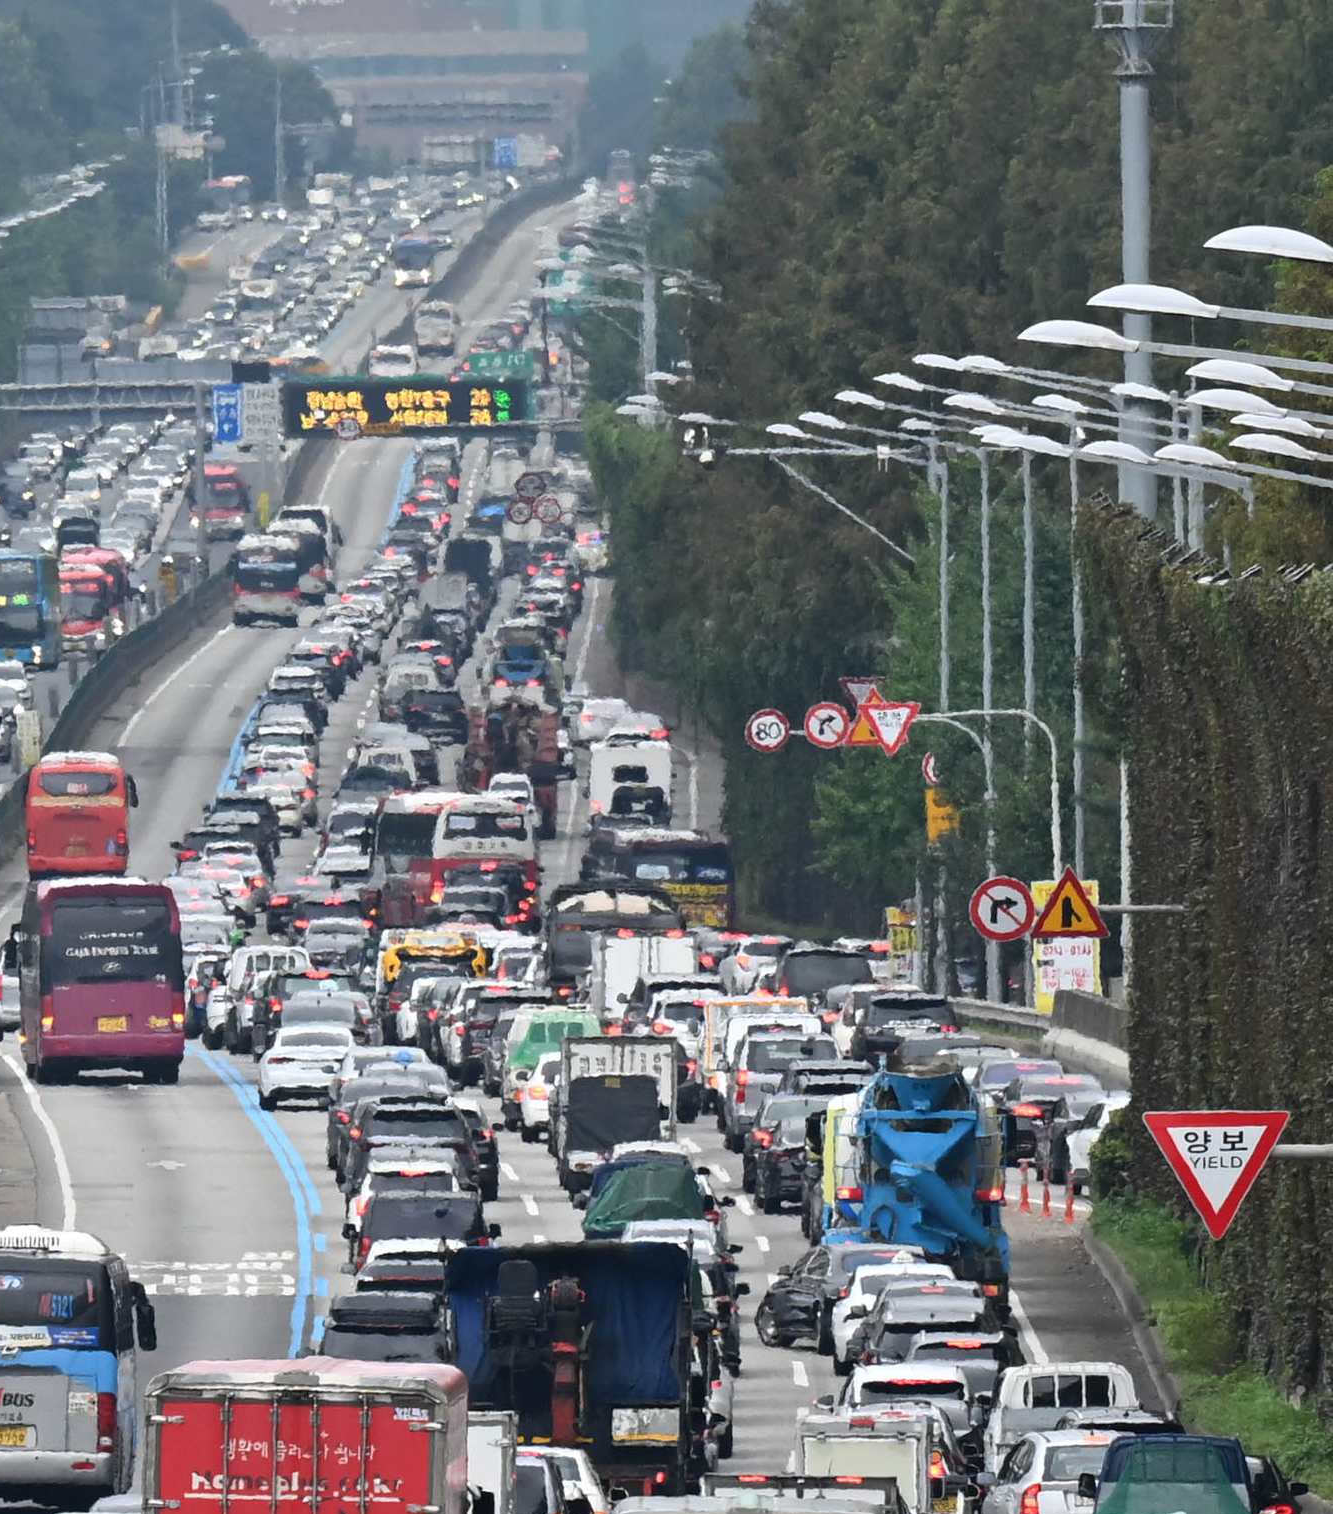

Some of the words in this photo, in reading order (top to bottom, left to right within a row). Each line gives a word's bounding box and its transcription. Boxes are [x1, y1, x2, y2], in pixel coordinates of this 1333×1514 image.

[755, 722, 781, 741] 80
[1184, 1130, 1248, 1154] 양보
[1190, 1156, 1243, 1169] YIELD
